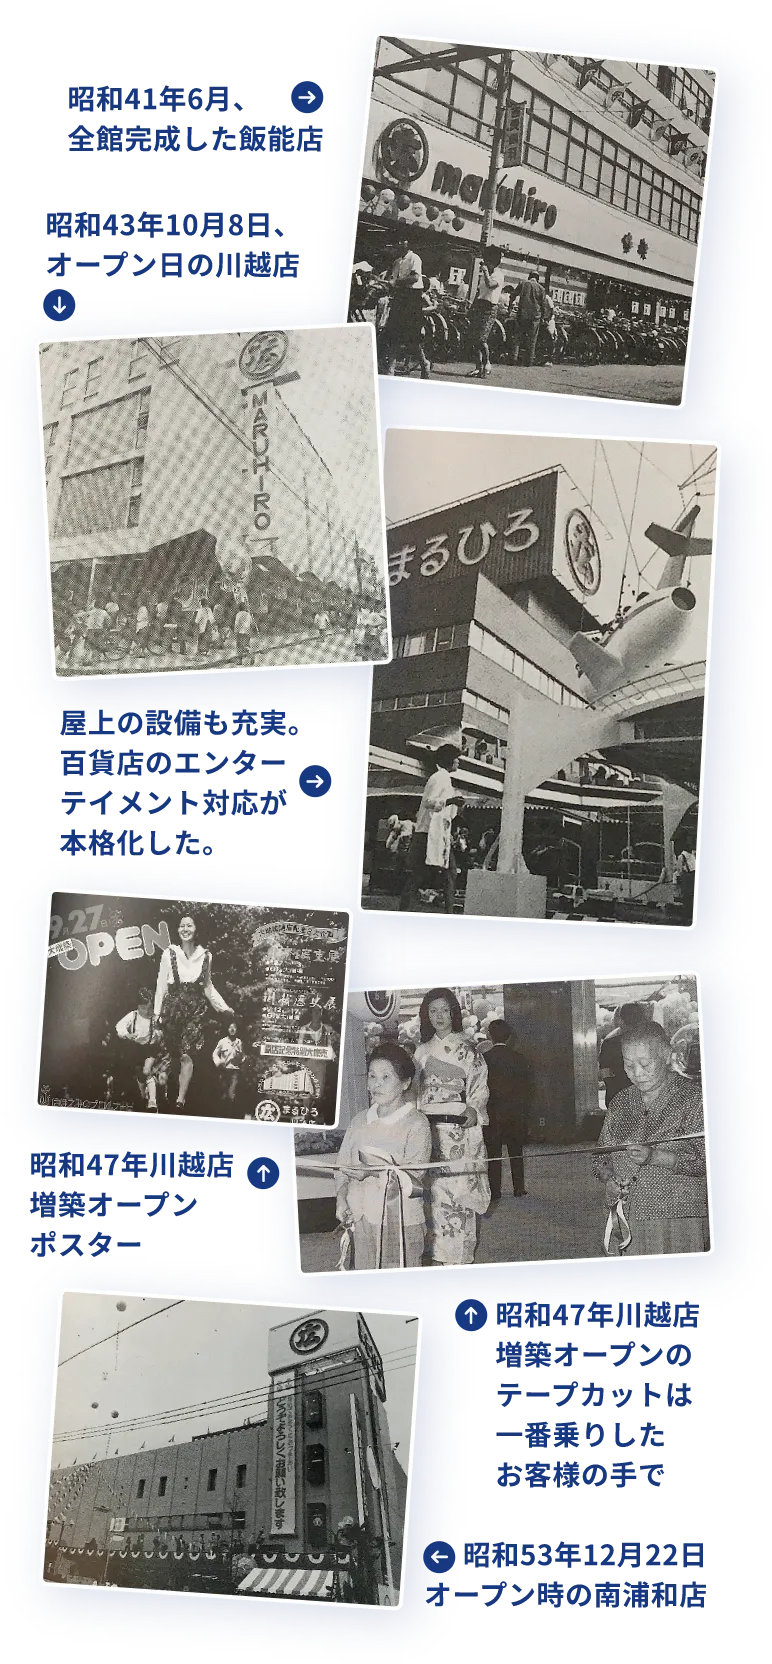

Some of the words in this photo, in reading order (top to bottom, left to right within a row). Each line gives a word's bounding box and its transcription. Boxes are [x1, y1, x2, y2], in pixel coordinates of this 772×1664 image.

[252, 390, 271, 531] MARUHIRO
[388, 508, 539, 586] まるひろ
[57, 921, 171, 970] OPEN
[282, 1105, 319, 1117] まるひろ
